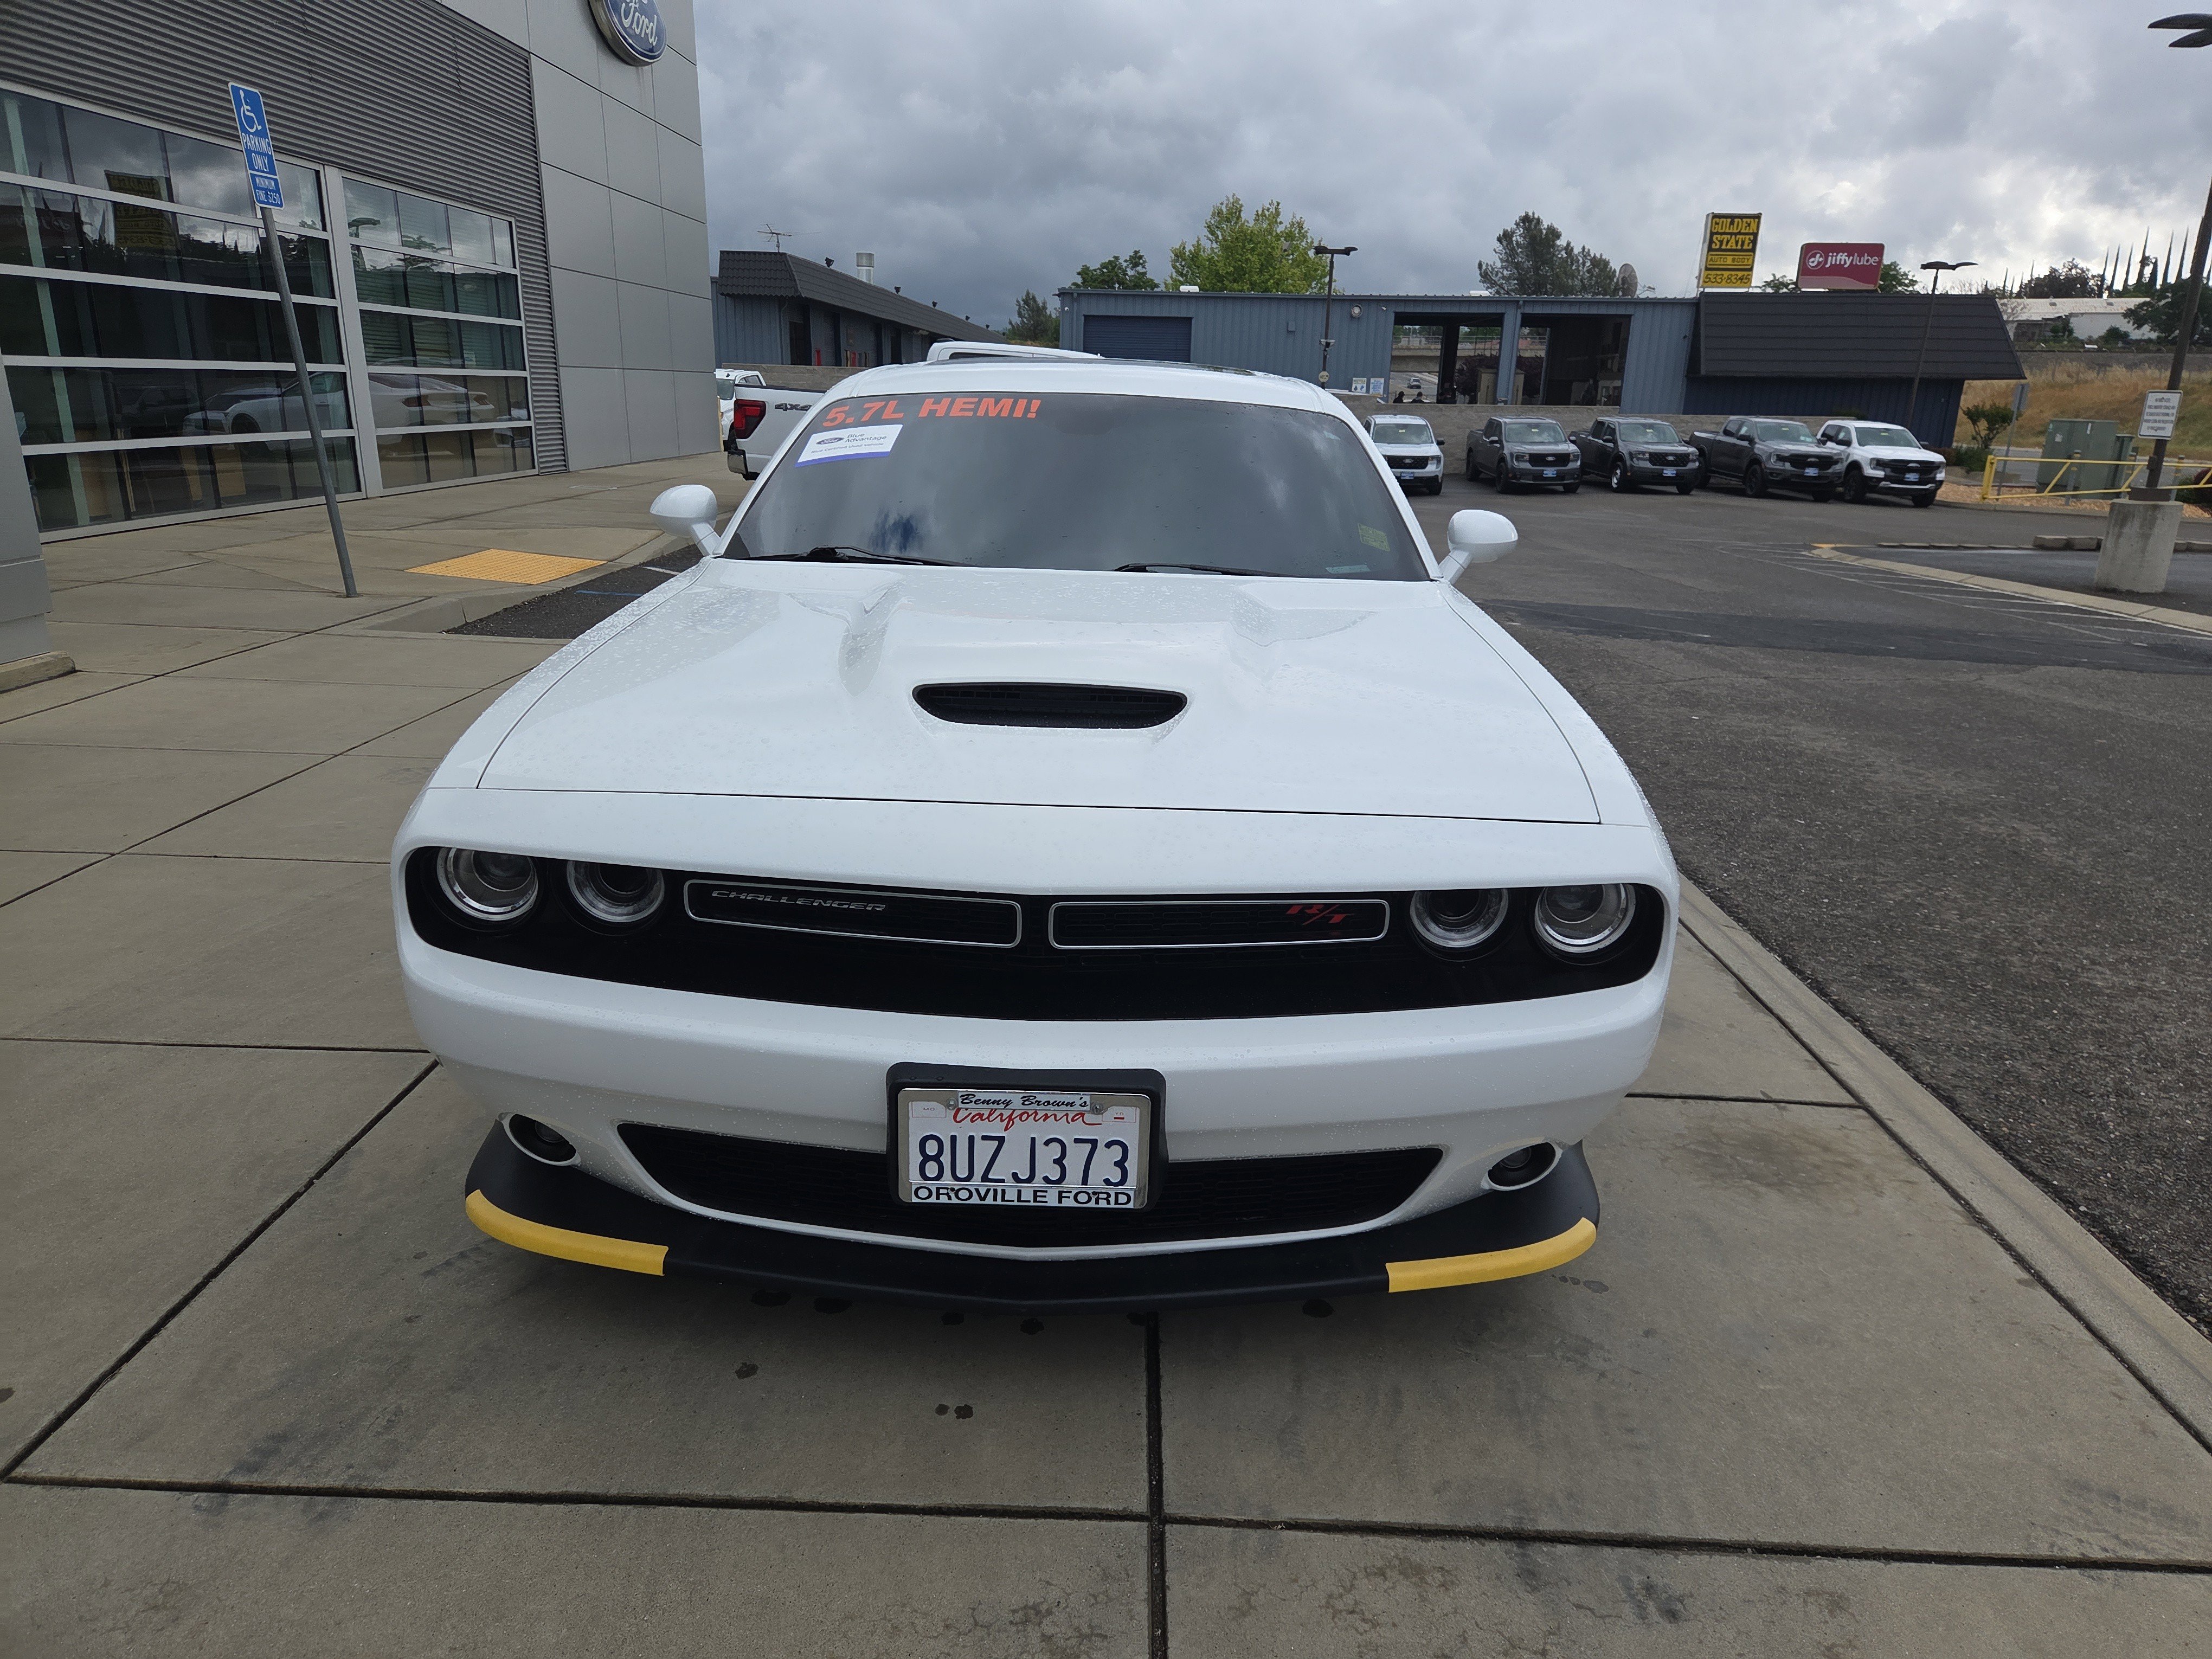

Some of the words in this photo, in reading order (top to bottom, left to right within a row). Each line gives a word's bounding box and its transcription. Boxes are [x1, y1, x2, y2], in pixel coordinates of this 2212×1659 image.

[621, 0, 658, 46] Ford
[242, 132, 271, 155] PARKING
[252, 153, 269, 172] ONLY
[256, 189, 267, 202] FINE
[268, 191, 280, 204] $250
[1712, 218, 1758, 233] GOLDEN
[1712, 235, 1754, 249] STATE
[822, 400, 904, 427] 5.7L
[918, 397, 1041, 419] HEMI!
[712, 890, 886, 911] CHALLENGER
[1285, 904, 1355, 925] R/T
[959, 1093, 1013, 1108] Benny
[1020, 1095, 1089, 1108] Brown's
[953, 1108, 1102, 1131] California
[918, 1134, 1129, 1187] 8UZJ373
[914, 1186, 1048, 1204] OROVILLE
[1057, 1190, 1132, 1206] FORD
